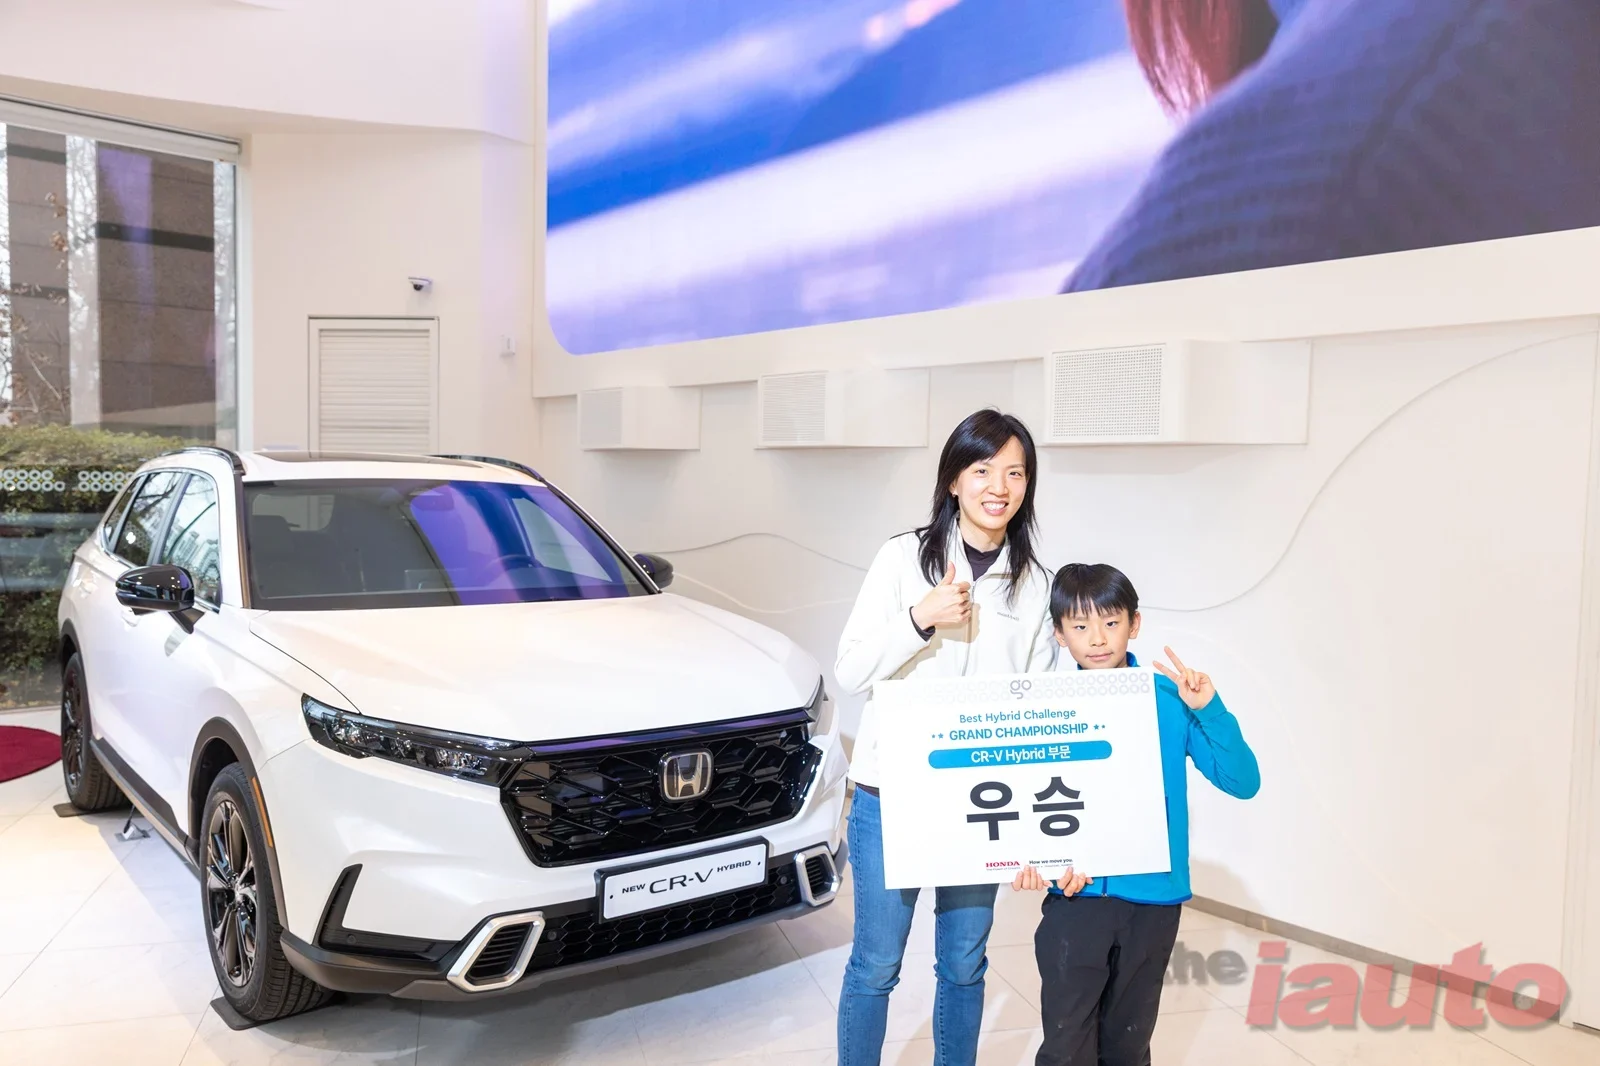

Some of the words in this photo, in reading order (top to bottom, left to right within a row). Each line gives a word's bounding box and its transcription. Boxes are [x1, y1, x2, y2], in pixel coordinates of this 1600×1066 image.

[959, 713, 982, 724] Best
[985, 710, 1021, 723] Hybrid
[1023, 708, 1077, 721] Challenge
[949, 728, 993, 741] GRAND
[995, 723, 1089, 739] CHAMPIONSHIP
[971, 751, 1003, 763] CR-V
[1005, 748, 1046, 763] Hybrid
[1048, 745, 1071, 759] 부문
[966, 776, 1085, 841] 우승
[622, 883, 646, 894] NEW
[649, 868, 714, 894] CR-V
[716, 860, 751, 873] HYBRID
